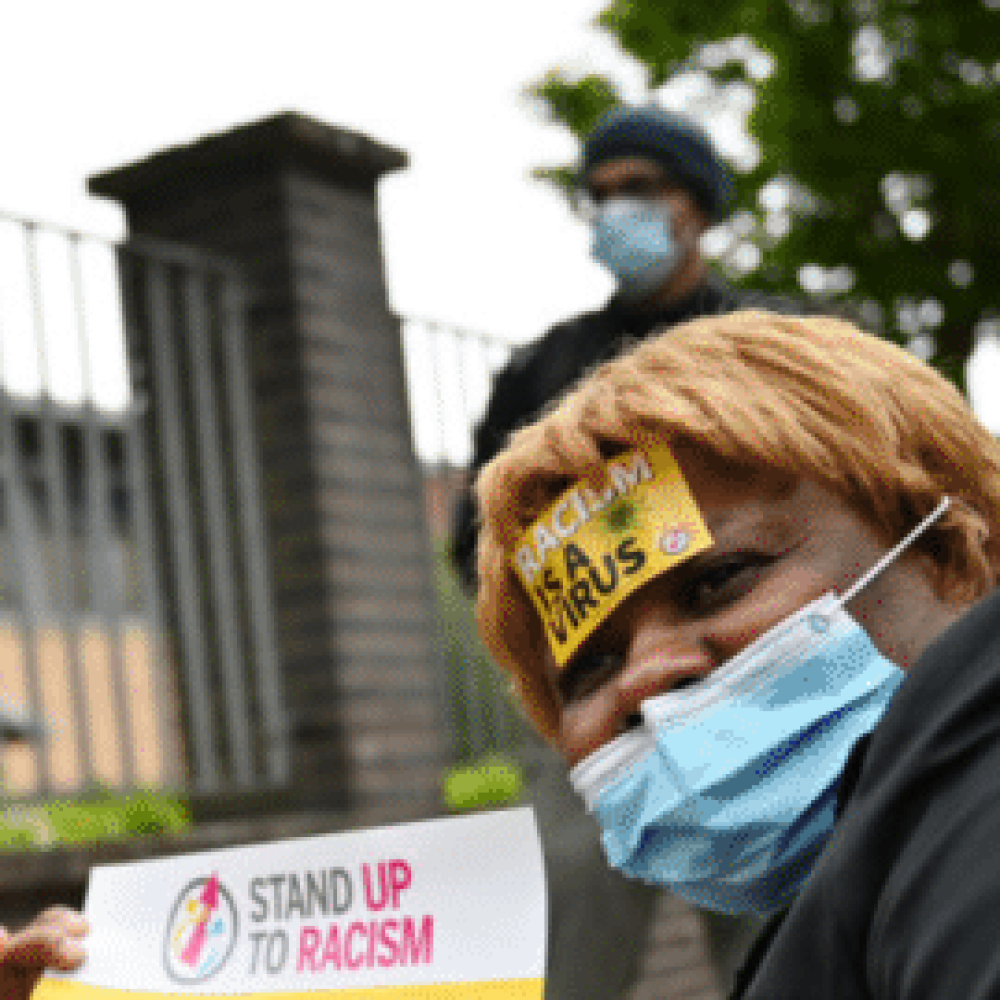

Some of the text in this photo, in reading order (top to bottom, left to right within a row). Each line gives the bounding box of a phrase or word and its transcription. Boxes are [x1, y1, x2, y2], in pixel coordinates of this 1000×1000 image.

[550, 537, 647, 645] VIRUS
[563, 543, 591, 579] A
[249, 859, 413, 922] STAND UP
[248, 914, 434, 974] TO RACISM
